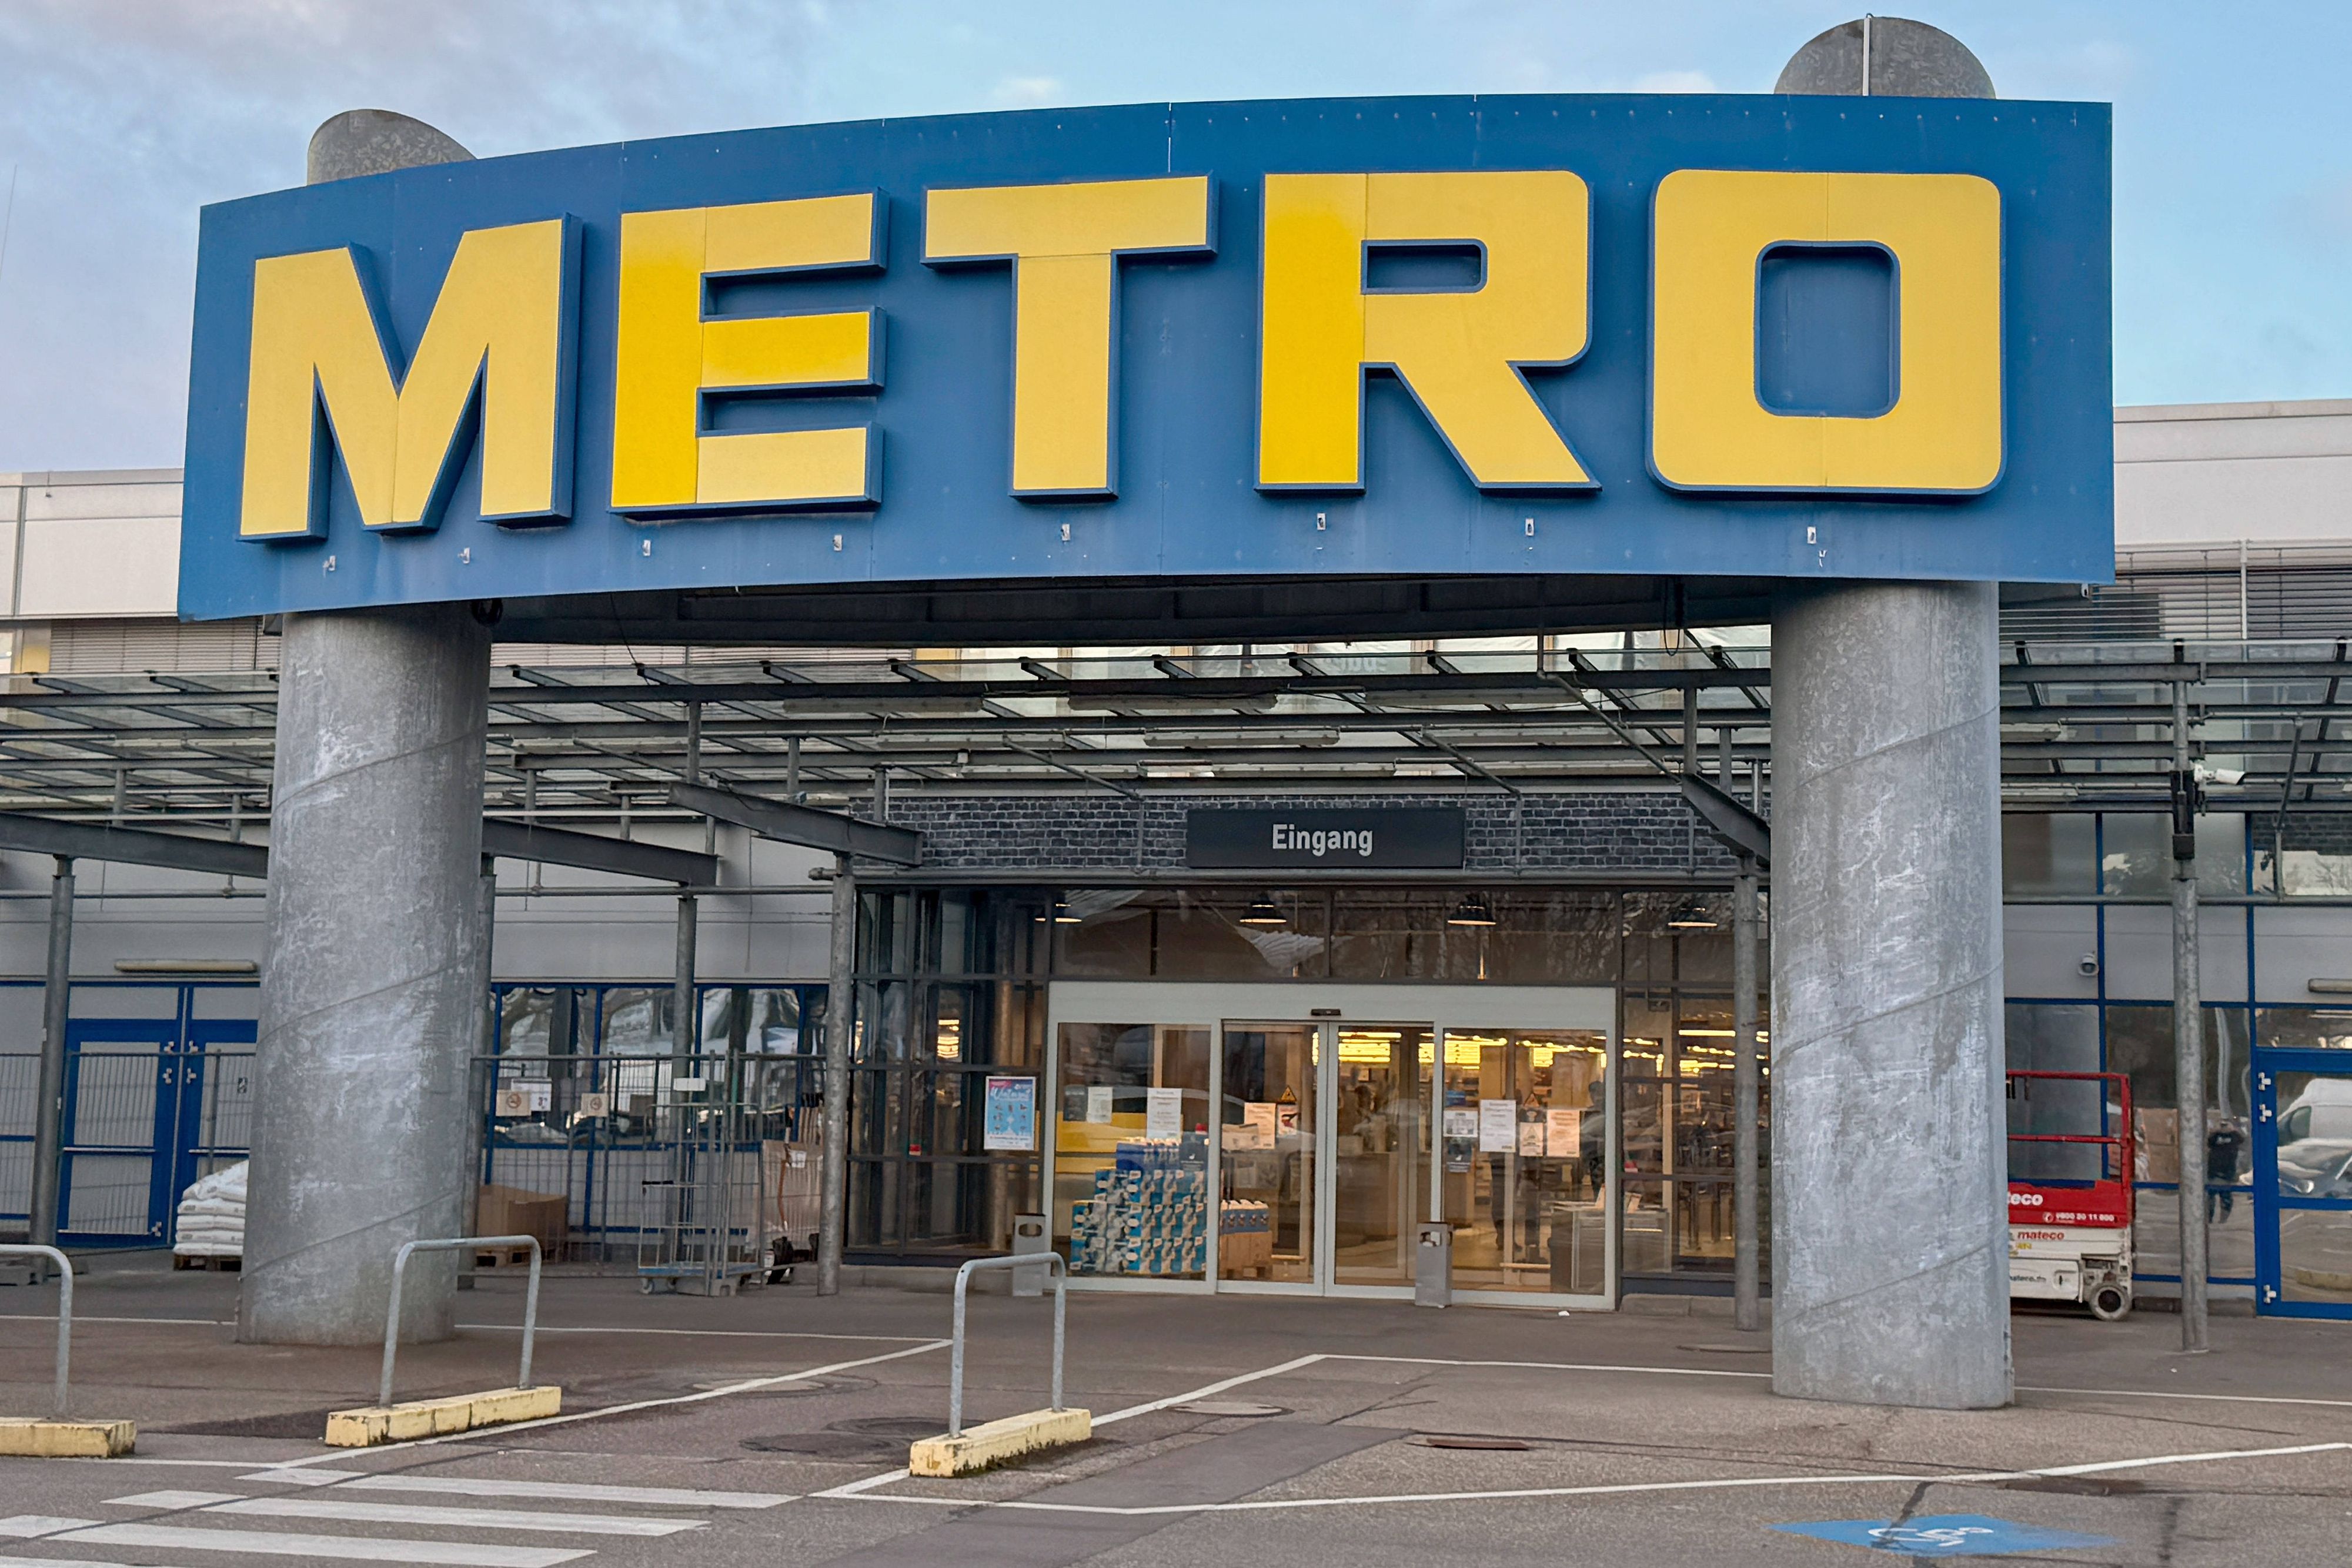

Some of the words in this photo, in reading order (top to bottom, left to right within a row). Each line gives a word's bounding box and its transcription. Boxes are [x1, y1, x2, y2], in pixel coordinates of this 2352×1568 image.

[238, 167, 2004, 539] METRO
[1272, 824, 1373, 857] Eingang
[2017, 1231, 2064, 1241] mateco
